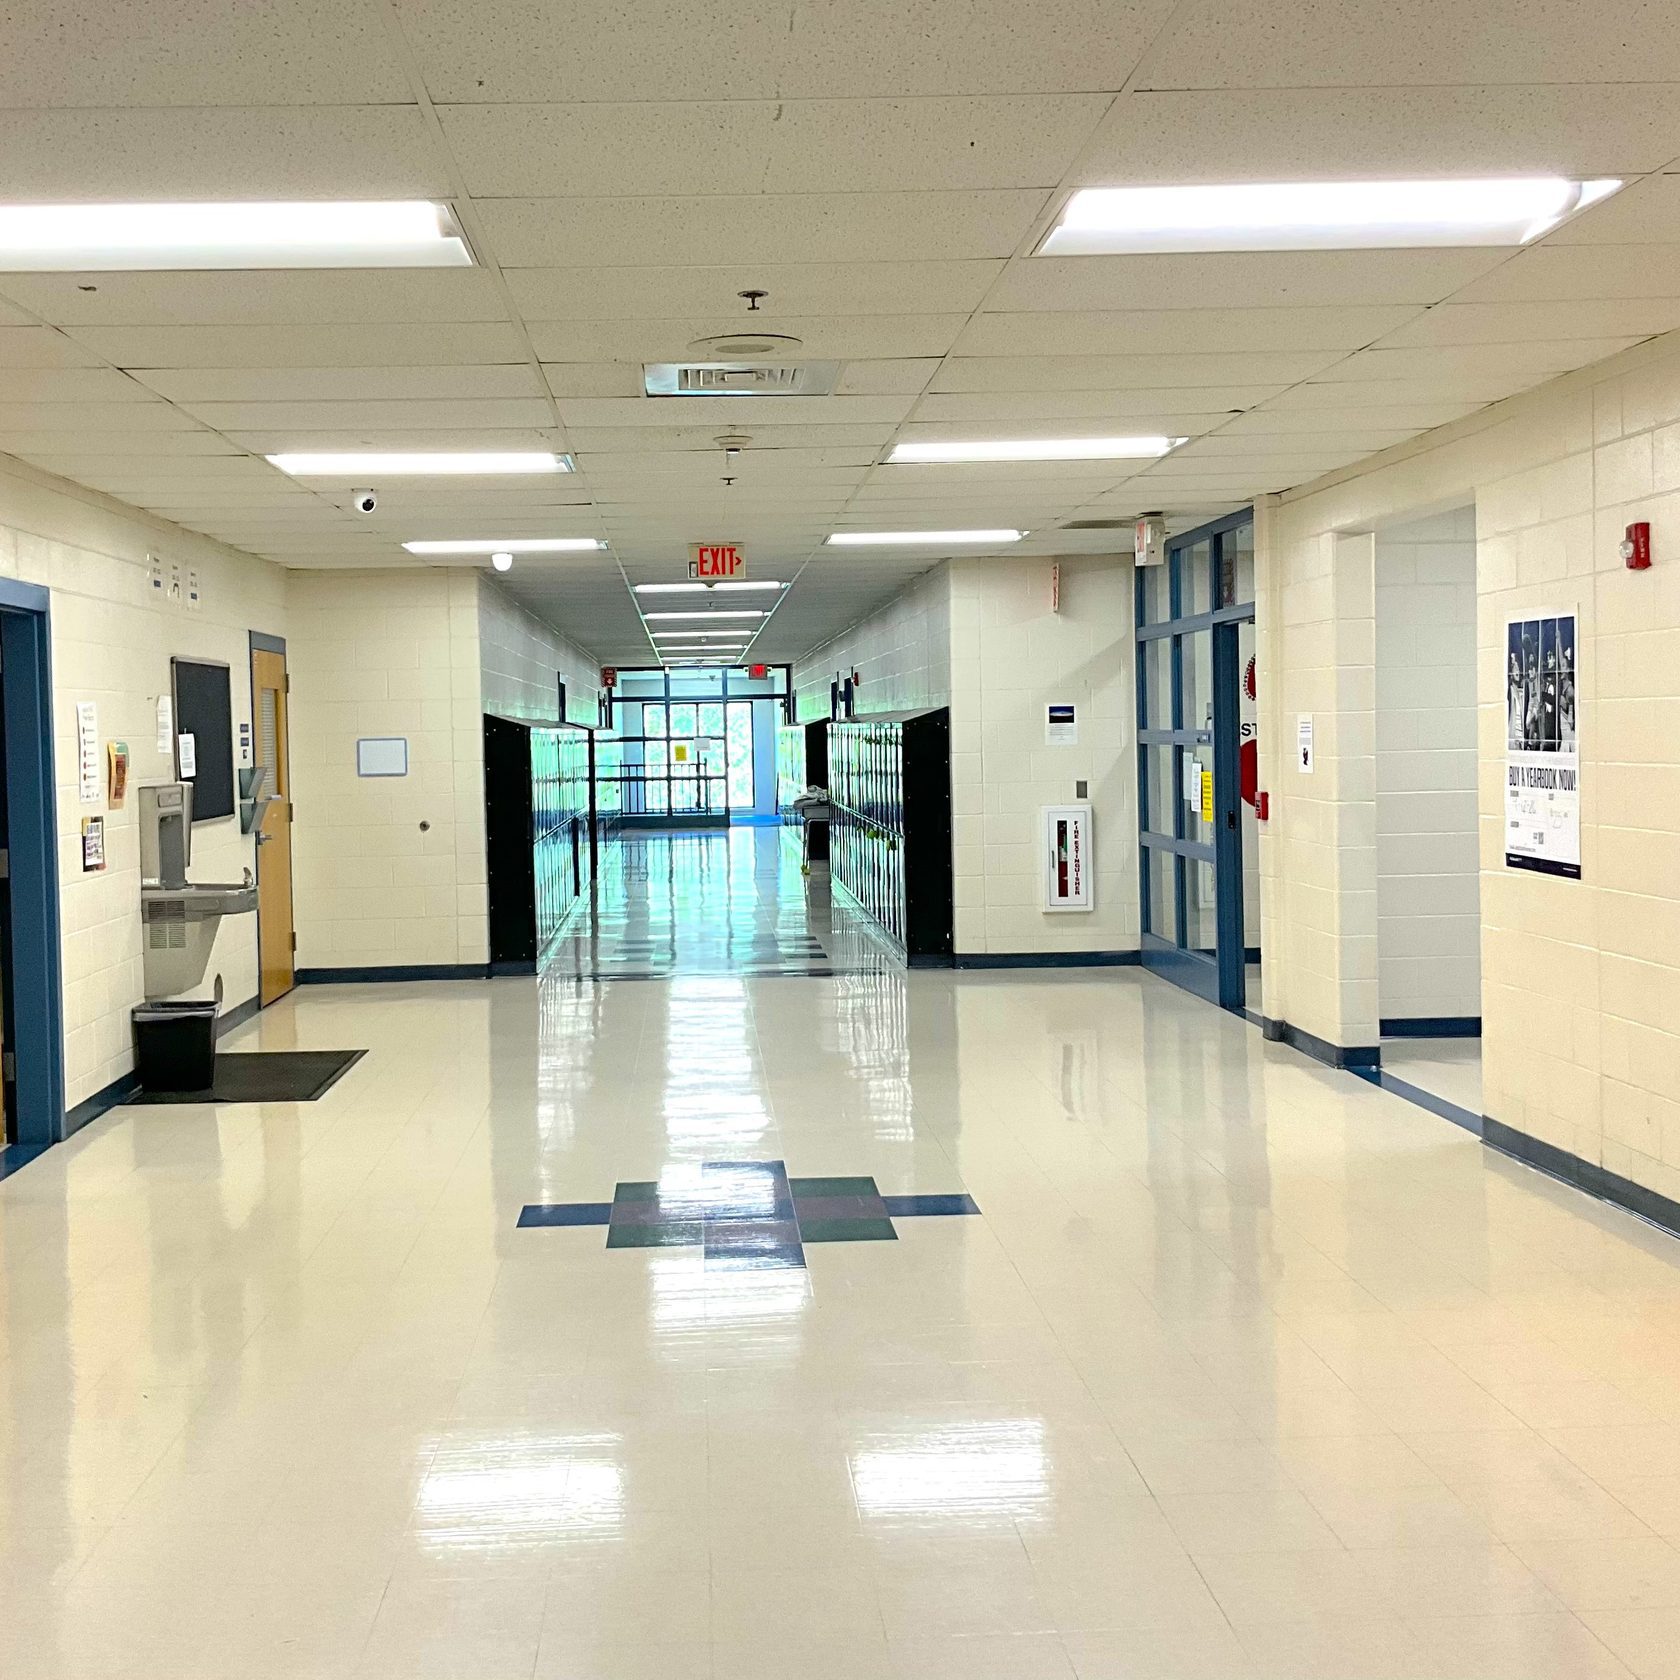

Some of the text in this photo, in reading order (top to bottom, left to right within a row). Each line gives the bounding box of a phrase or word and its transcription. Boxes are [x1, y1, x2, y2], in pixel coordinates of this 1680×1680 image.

[699, 547, 736, 575] EXIT
[1509, 766, 1576, 791] BUY A YEARBOOK NOW!
